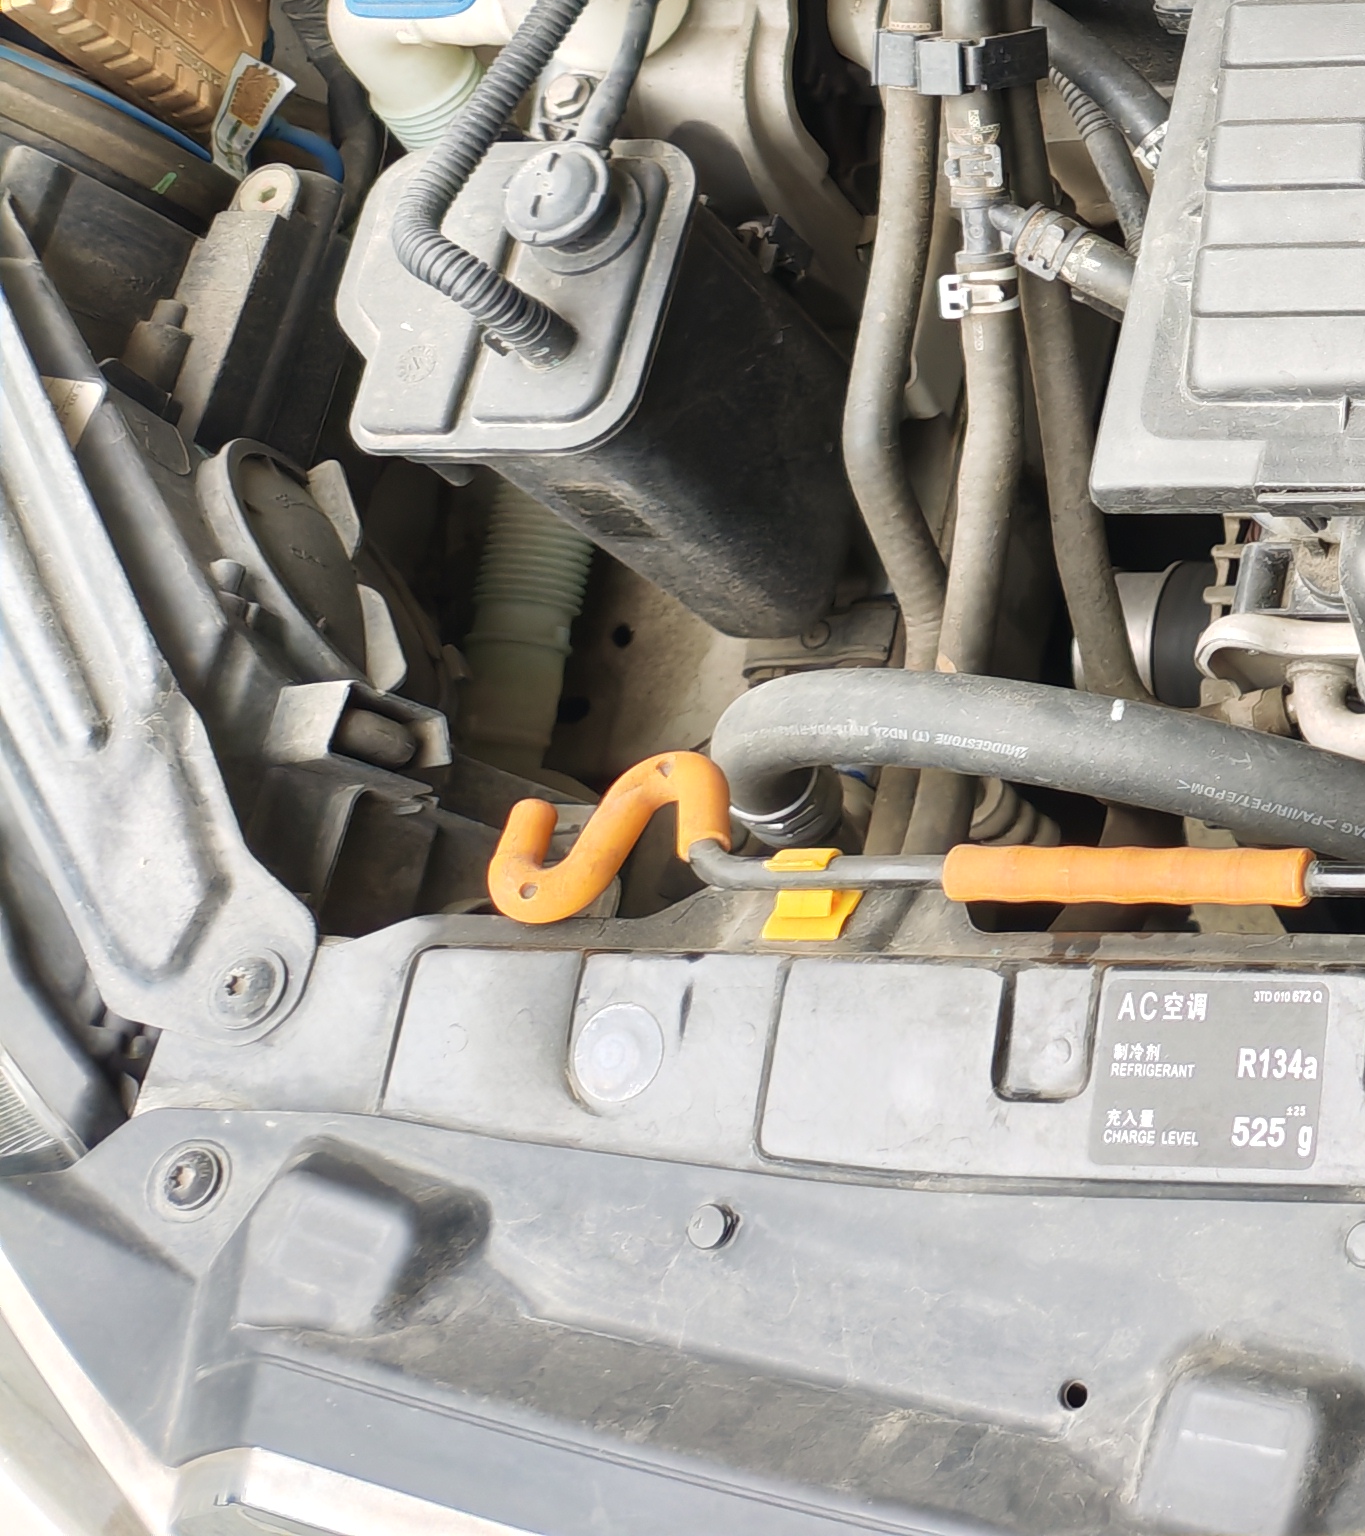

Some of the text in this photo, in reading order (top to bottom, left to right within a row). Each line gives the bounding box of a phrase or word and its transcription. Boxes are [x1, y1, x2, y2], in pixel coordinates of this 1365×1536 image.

[1117, 992, 1208, 1022] AC 空调
[1253, 991, 1273, 1004] 3TD
[1273, 991, 1292, 1004] 010
[1292, 990, 1312, 1004] 672
[1113, 1043, 1161, 1062] 制冷剂
[1110, 1062, 1195, 1079] REFRIGERANT
[1237, 1047, 1318, 1081] R134a
[1106, 1108, 1155, 1129] 充入量
[1103, 1129, 1199, 1146] CHARGE LEVEL
[1231, 1117, 1286, 1148] 525
[1297, 1125, 1314, 1157] g
